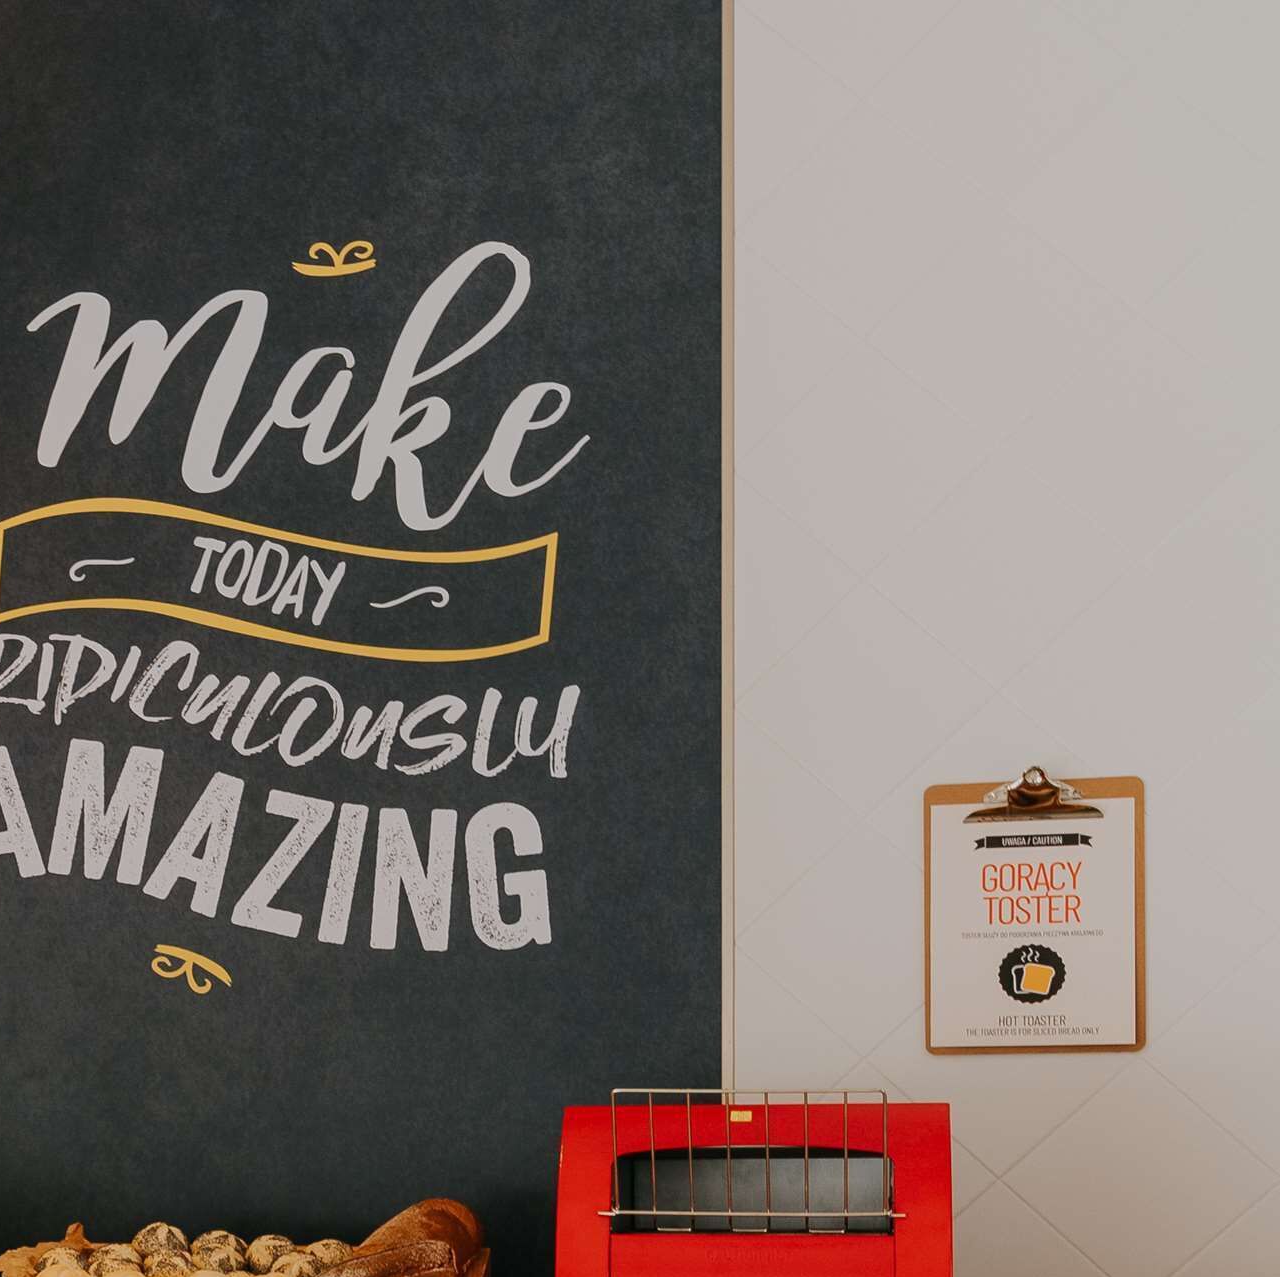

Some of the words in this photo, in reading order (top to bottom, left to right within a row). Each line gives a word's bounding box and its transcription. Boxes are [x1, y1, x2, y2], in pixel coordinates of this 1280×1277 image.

[27, 241, 590, 531] Make
[191, 537, 346, 625] TODAY
[1002, 836, 1026, 847] UWAGA
[1032, 834, 1063, 845] CAUTION
[982, 861, 1082, 897] GORĄCY
[983, 895, 1081, 925] TOSTER
[966, 1028, 977, 1037] THE
[981, 1028, 1009, 1037] TOASTER
[1010, 1028, 1017, 1036] IS
[1018, 1028, 1032, 1036] FOR
[1033, 1027, 1057, 1036] SLICED
[1058, 1026, 1081, 1035] BREAD
[1082, 1026, 1100, 1035] ONLY
[998, 1015, 1018, 1027] HOT
[1023, 1014, 1067, 1026] TOASTER
